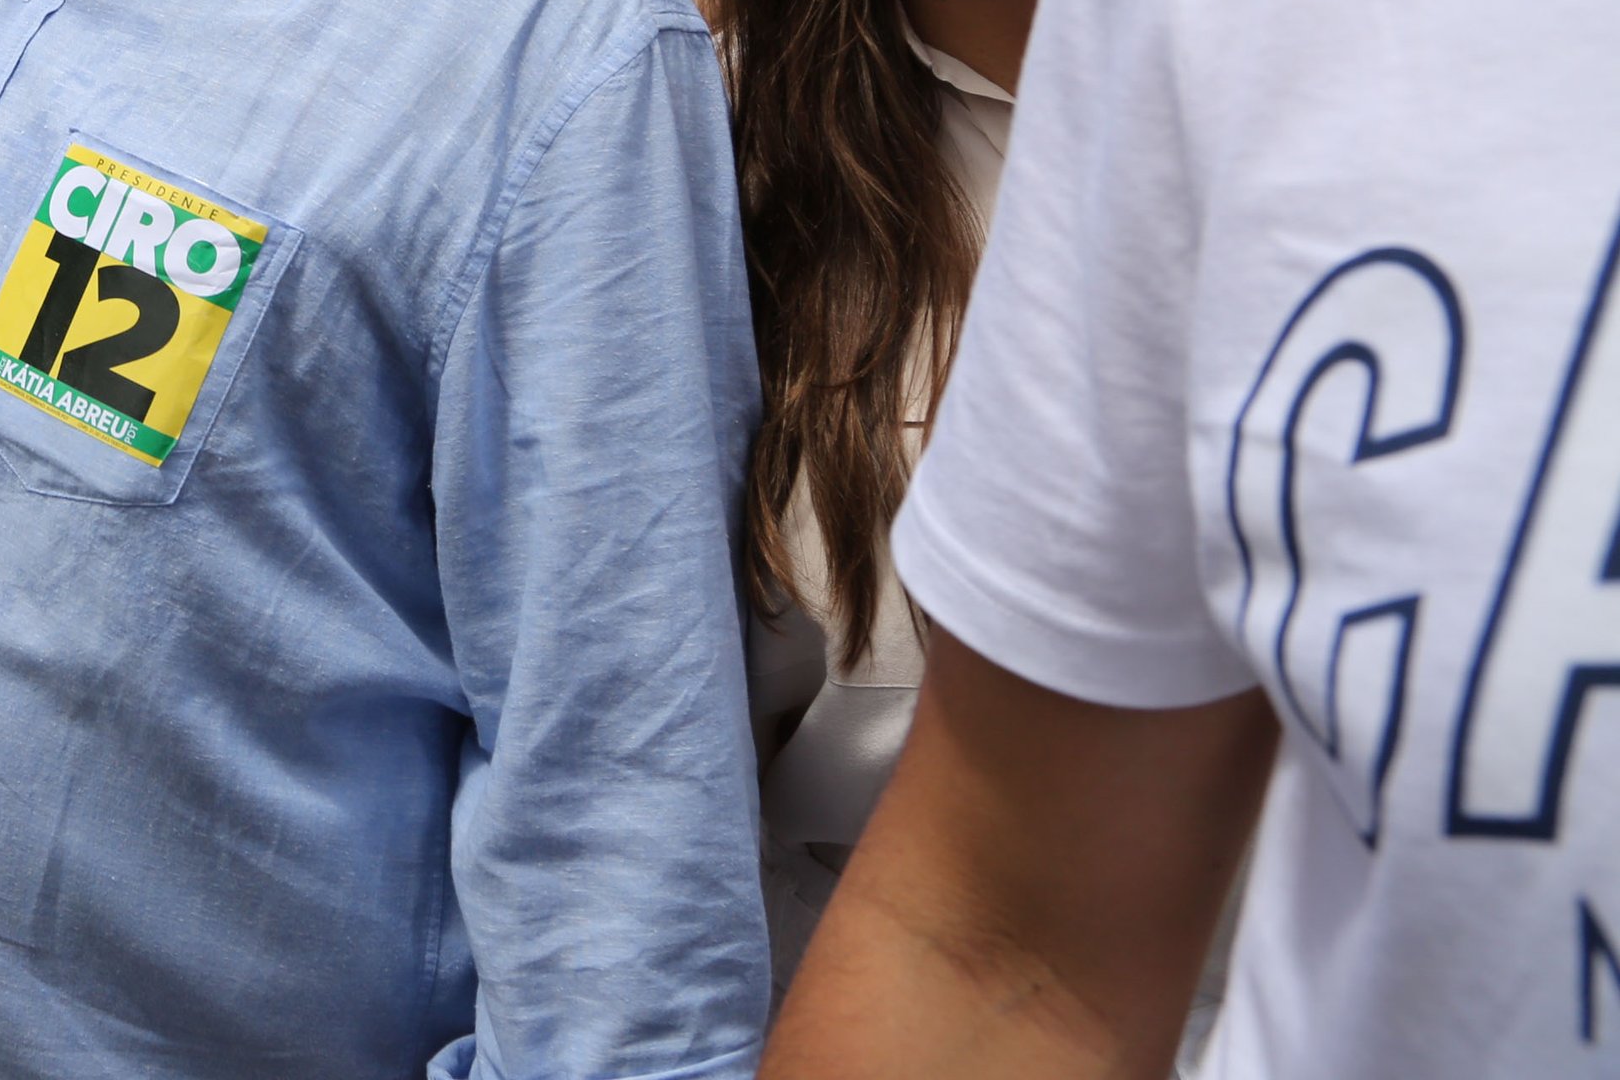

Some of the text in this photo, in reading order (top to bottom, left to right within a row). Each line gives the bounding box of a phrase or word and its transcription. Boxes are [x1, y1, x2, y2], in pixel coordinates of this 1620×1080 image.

[96, 158, 220, 221] PRESIDENTE
[48, 165, 242, 297] CIRO
[19, 230, 180, 424] 12
[0, 358, 55, 404] KÁTIA
[55, 391, 130, 439] ABREU
[124, 423, 139, 445] PDT
